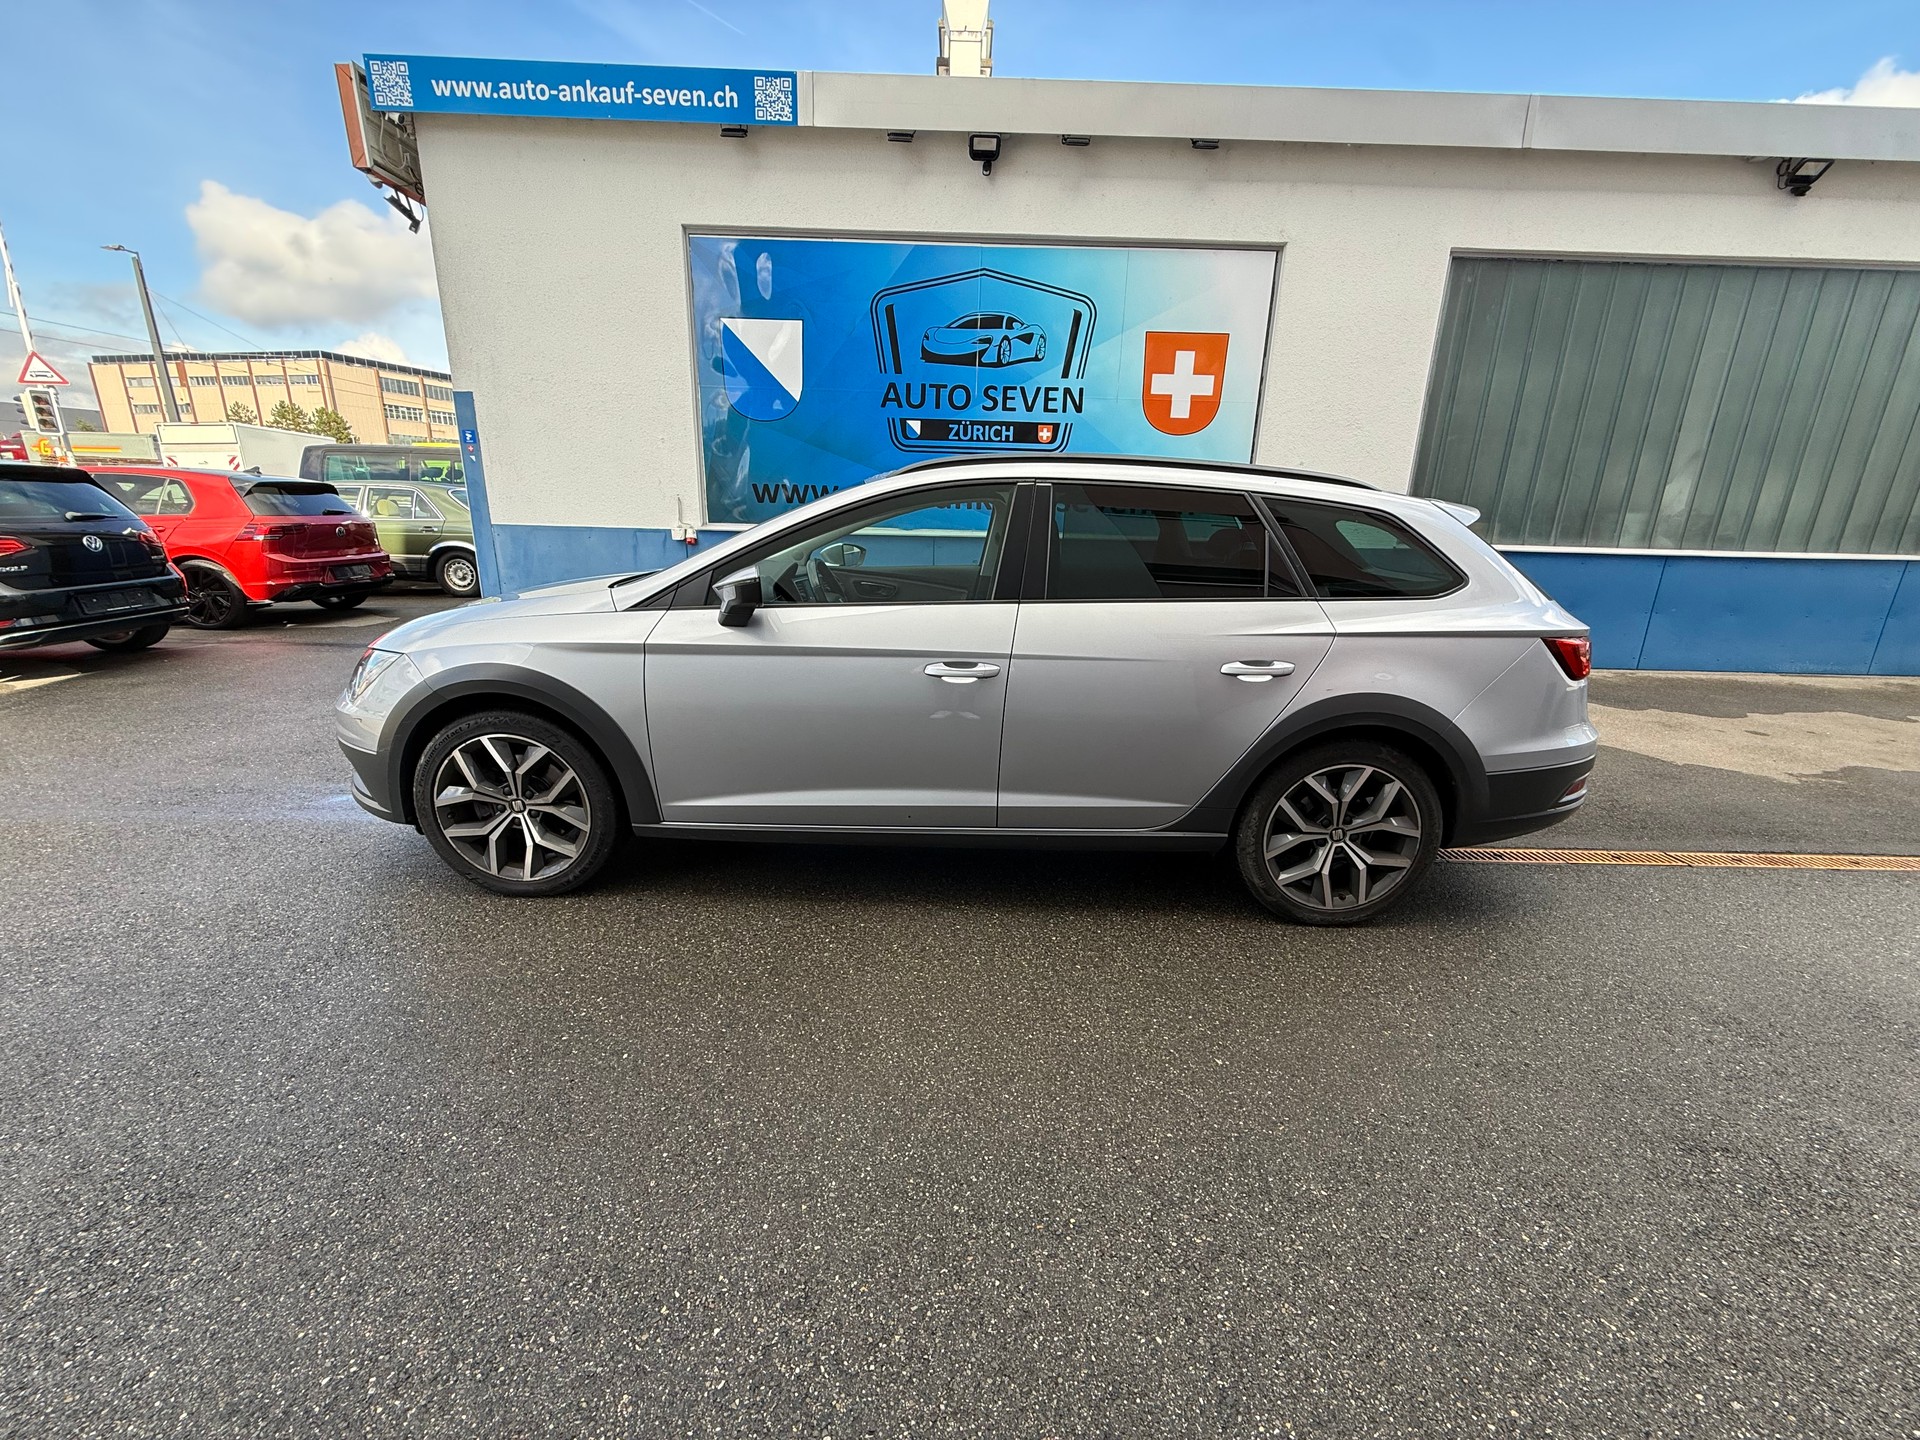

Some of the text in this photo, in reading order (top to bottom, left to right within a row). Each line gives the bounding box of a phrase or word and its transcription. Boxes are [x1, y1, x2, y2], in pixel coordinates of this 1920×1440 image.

[431, 79, 738, 108] www.auto-ankauf-seven.ch
[880, 382, 1084, 414] AUTO SEVEN
[948, 420, 1014, 441] ZÜRICH
